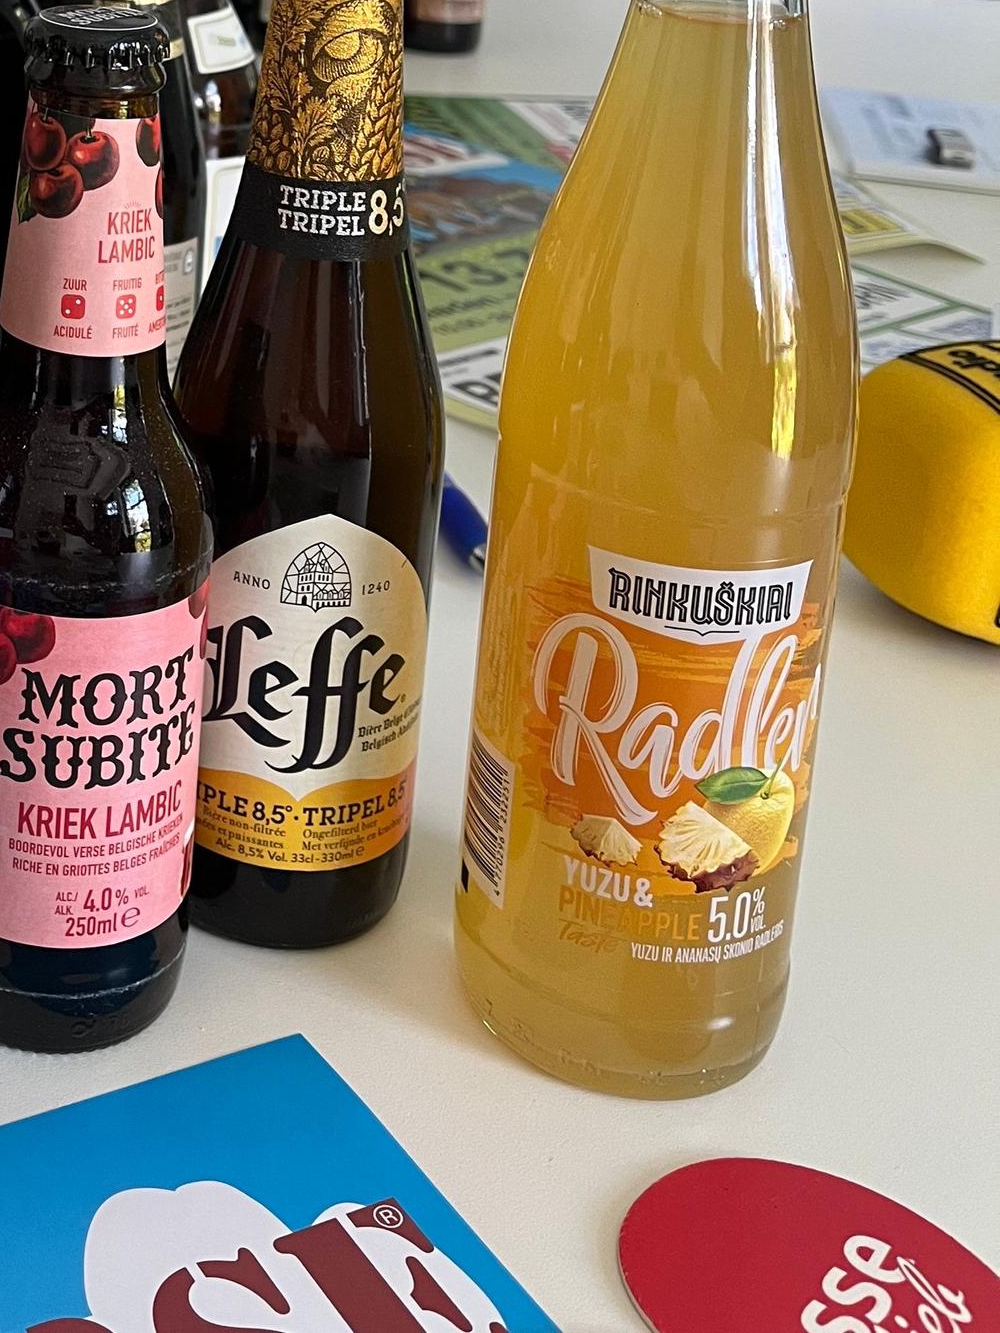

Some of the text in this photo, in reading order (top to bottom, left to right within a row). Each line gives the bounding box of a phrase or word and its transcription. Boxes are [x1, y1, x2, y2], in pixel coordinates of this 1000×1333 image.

[278, 184, 366, 212] TRIPLE
[107, 208, 152, 235] KRIEK
[277, 209, 365, 237] TRIPEL
[97, 235, 155, 264] LAMBIC
[63, 278, 87, 292] ZUUR
[112, 277, 143, 292] FRUITIG
[53, 324, 93, 340] ACIDULÉ
[112, 324, 139, 339] FRUITÉ
[232, 570, 391, 596] ANNO 1240
[608, 565, 794, 627] RINKUŠKIAI
[18, 644, 197, 728] MORT
[202, 615, 407, 774] Leffe
[532, 612, 823, 826] Radler
[0, 700, 197, 791] SUBITE
[17, 779, 182, 840] KRIEK LAMBIC
[197, 780, 248, 821] PLE
[302, 795, 385, 826] TRIPEL
[9, 837, 69, 858] BOORDEVOL
[73, 844, 105, 858] VERSE
[108, 831, 157, 856] BELGISCHE
[215, 838, 236, 852] Alc.
[238, 844, 264, 859] 8,5%
[267, 849, 288, 864] Vol.
[12, 857, 42, 874] RICHE
[45, 862, 59, 876] EN
[62, 862, 110, 876] GRIOTTES
[113, 854, 147, 873] BELGES
[564, 857, 653, 908] YUZU &
[83, 887, 112, 912] 4.0
[558, 884, 701, 941] PINEAPPLE
[64, 912, 117, 937] 250ml
[707, 890, 751, 943] 5.0
[631, 941, 659, 962] YUZU
[661, 947, 673, 963] IR
